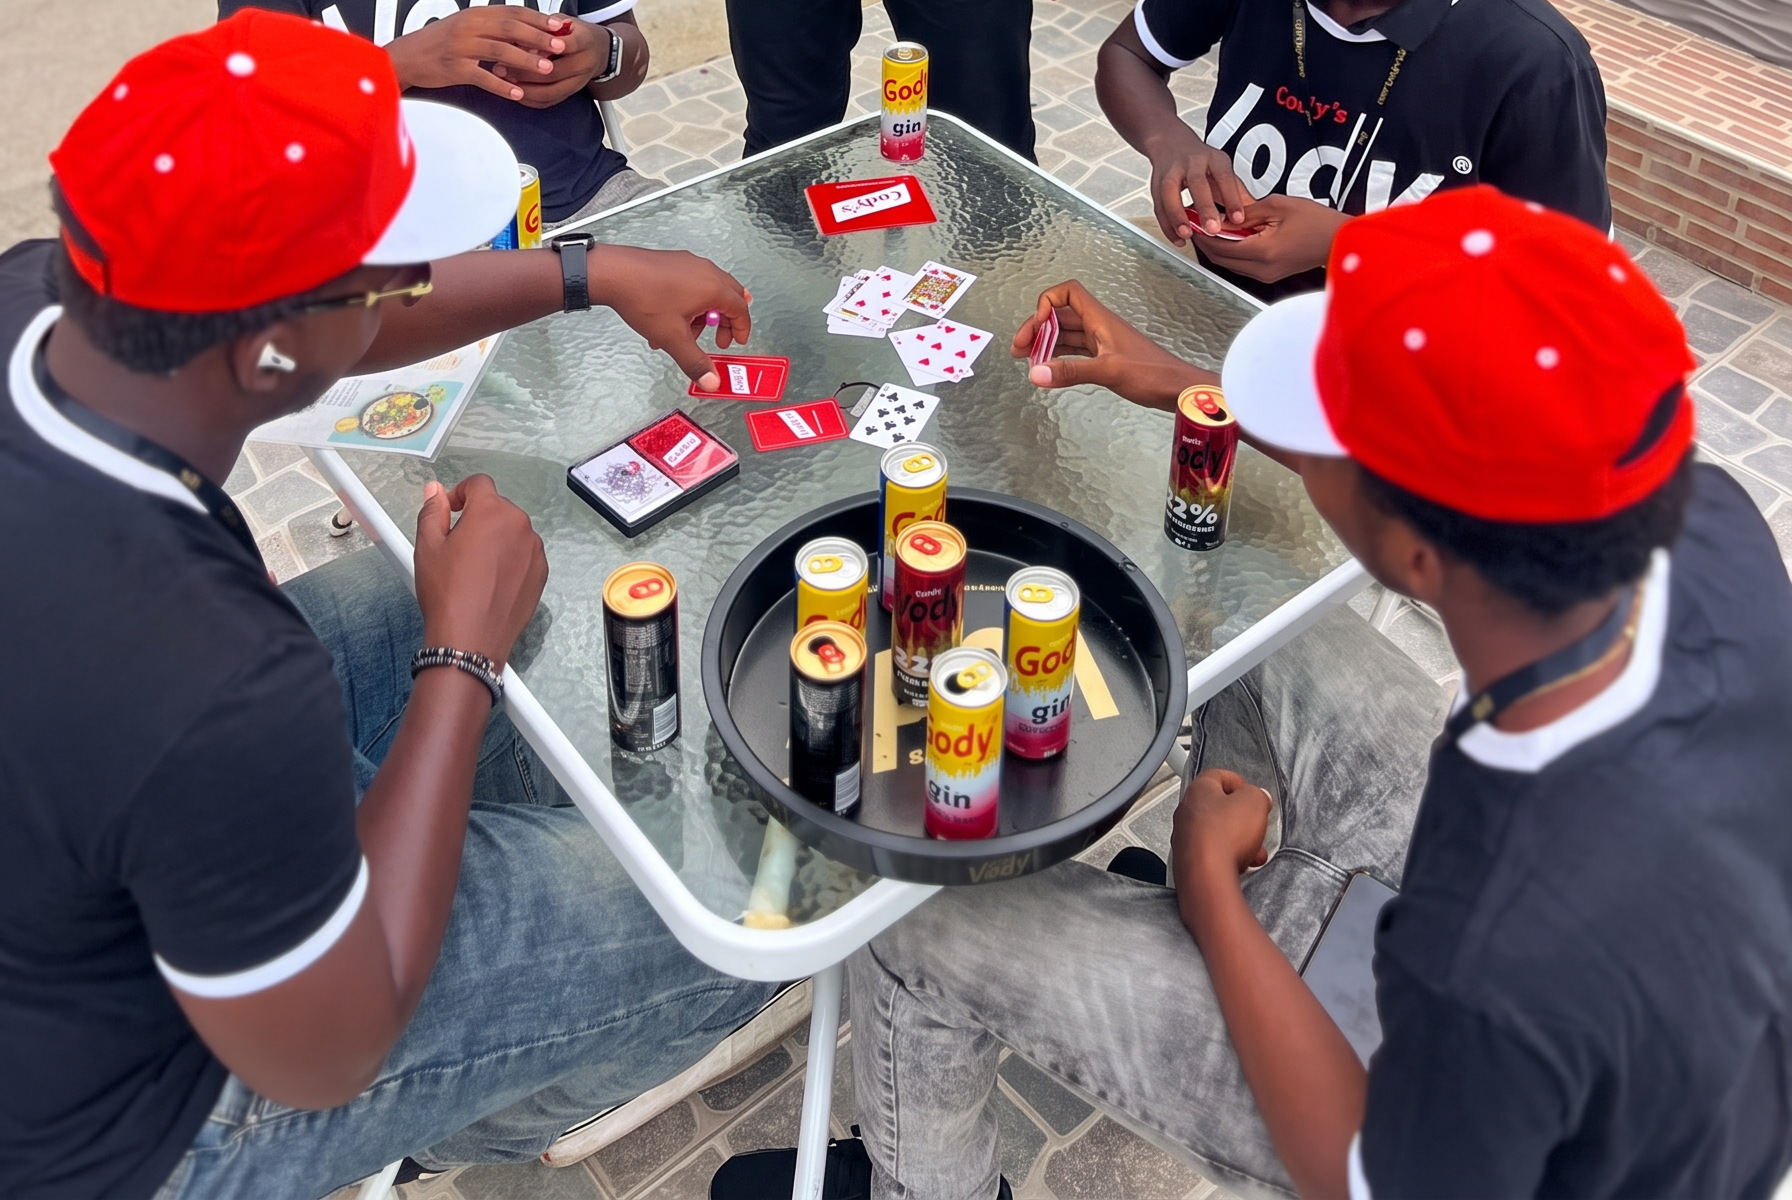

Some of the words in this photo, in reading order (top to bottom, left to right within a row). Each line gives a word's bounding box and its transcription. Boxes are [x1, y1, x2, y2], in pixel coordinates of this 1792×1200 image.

[892, 120, 922, 138] gin
[841, 191, 902, 213] Cody's
[1174, 441, 1228, 478] ody
[1166, 486, 1219, 525] 22%
[895, 646, 941, 673] 22
[1031, 693, 1071, 725] gin
[927, 779, 972, 810] gin
